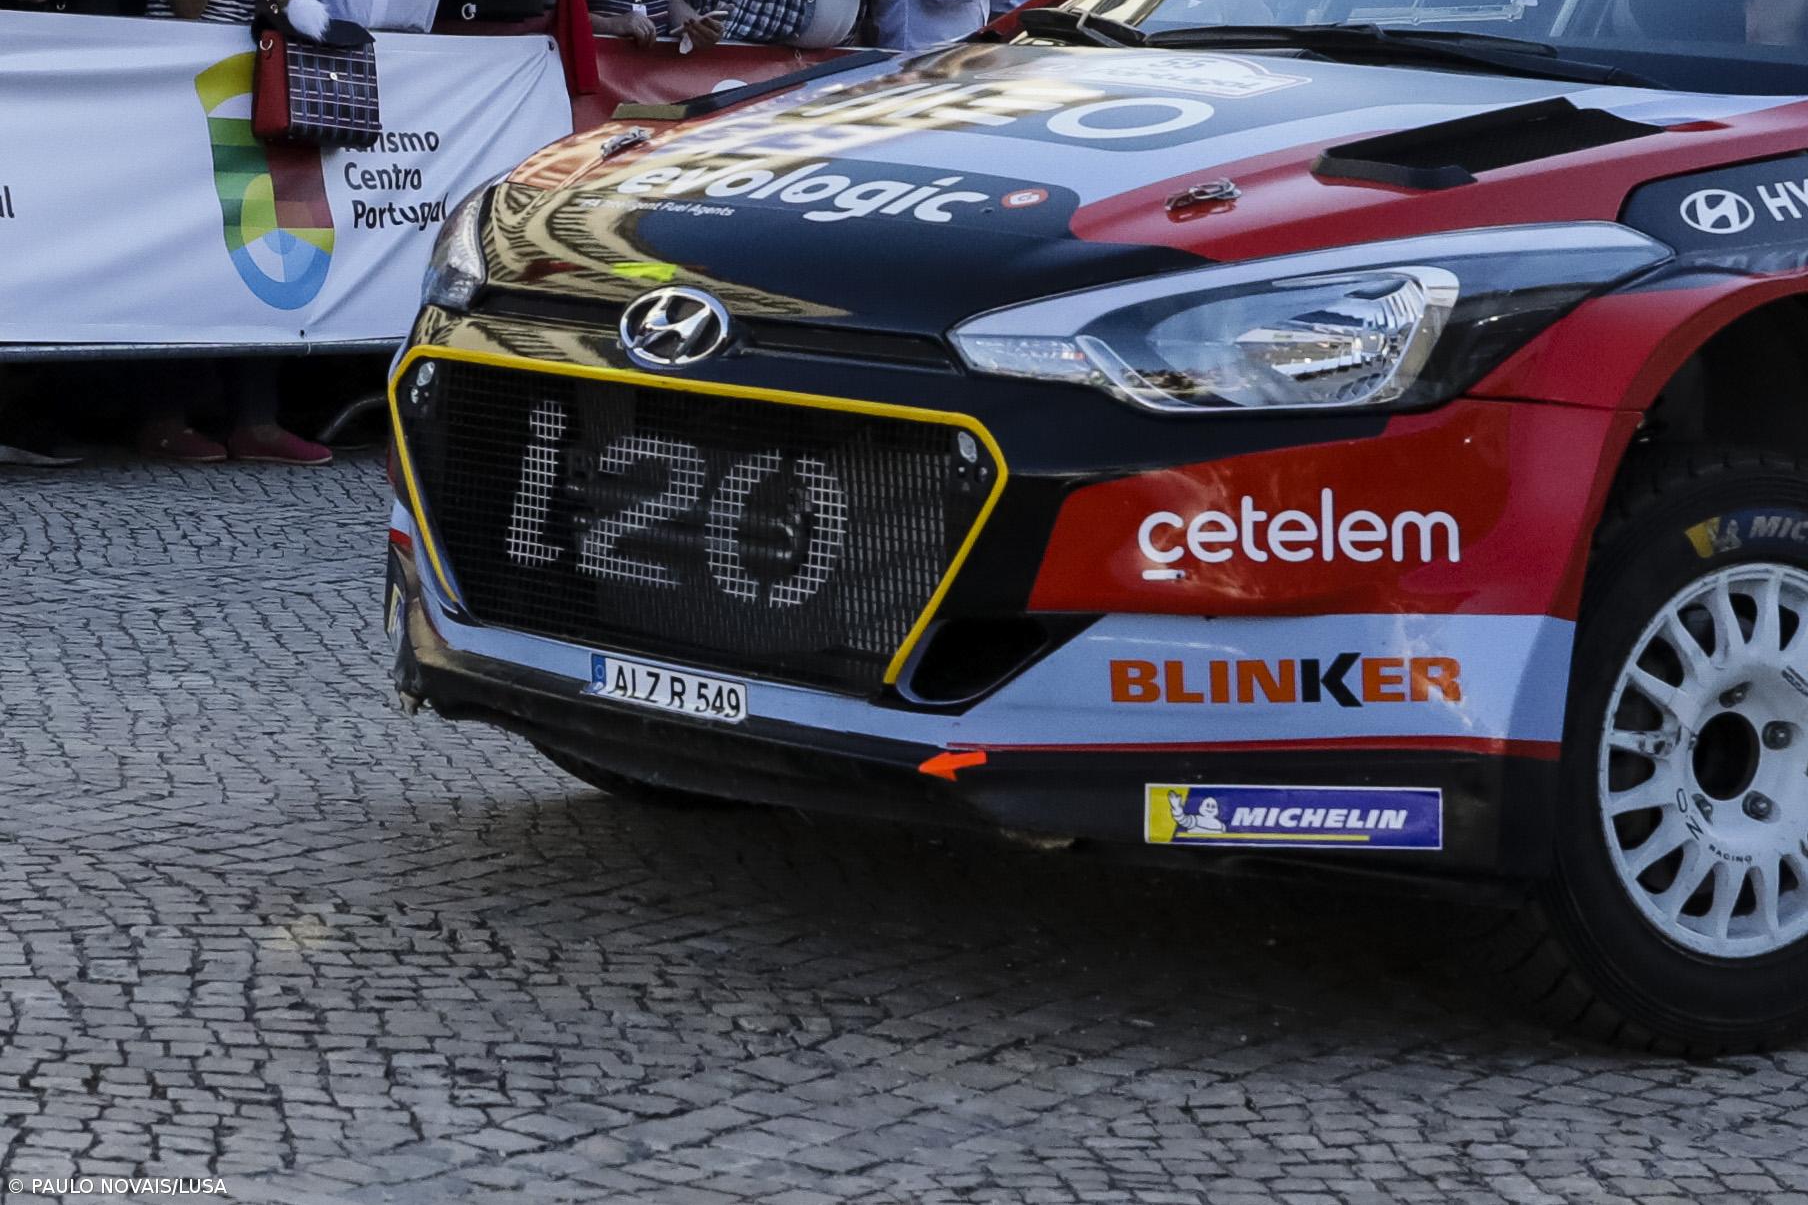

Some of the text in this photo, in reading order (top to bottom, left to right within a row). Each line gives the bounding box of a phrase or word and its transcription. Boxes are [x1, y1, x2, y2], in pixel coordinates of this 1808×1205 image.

[344, 161, 422, 190] Centro
[617, 159, 990, 223] evologic
[352, 193, 449, 232] Portugal
[661, 201, 688, 212] Fuel
[688, 203, 735, 217] Agents
[1138, 487, 1461, 564] cetelem
[666, 675, 687, 709] R
[694, 681, 741, 718] 549
[1109, 652, 1462, 708] BLINKER
[1231, 806, 1408, 831] MICHELIN
